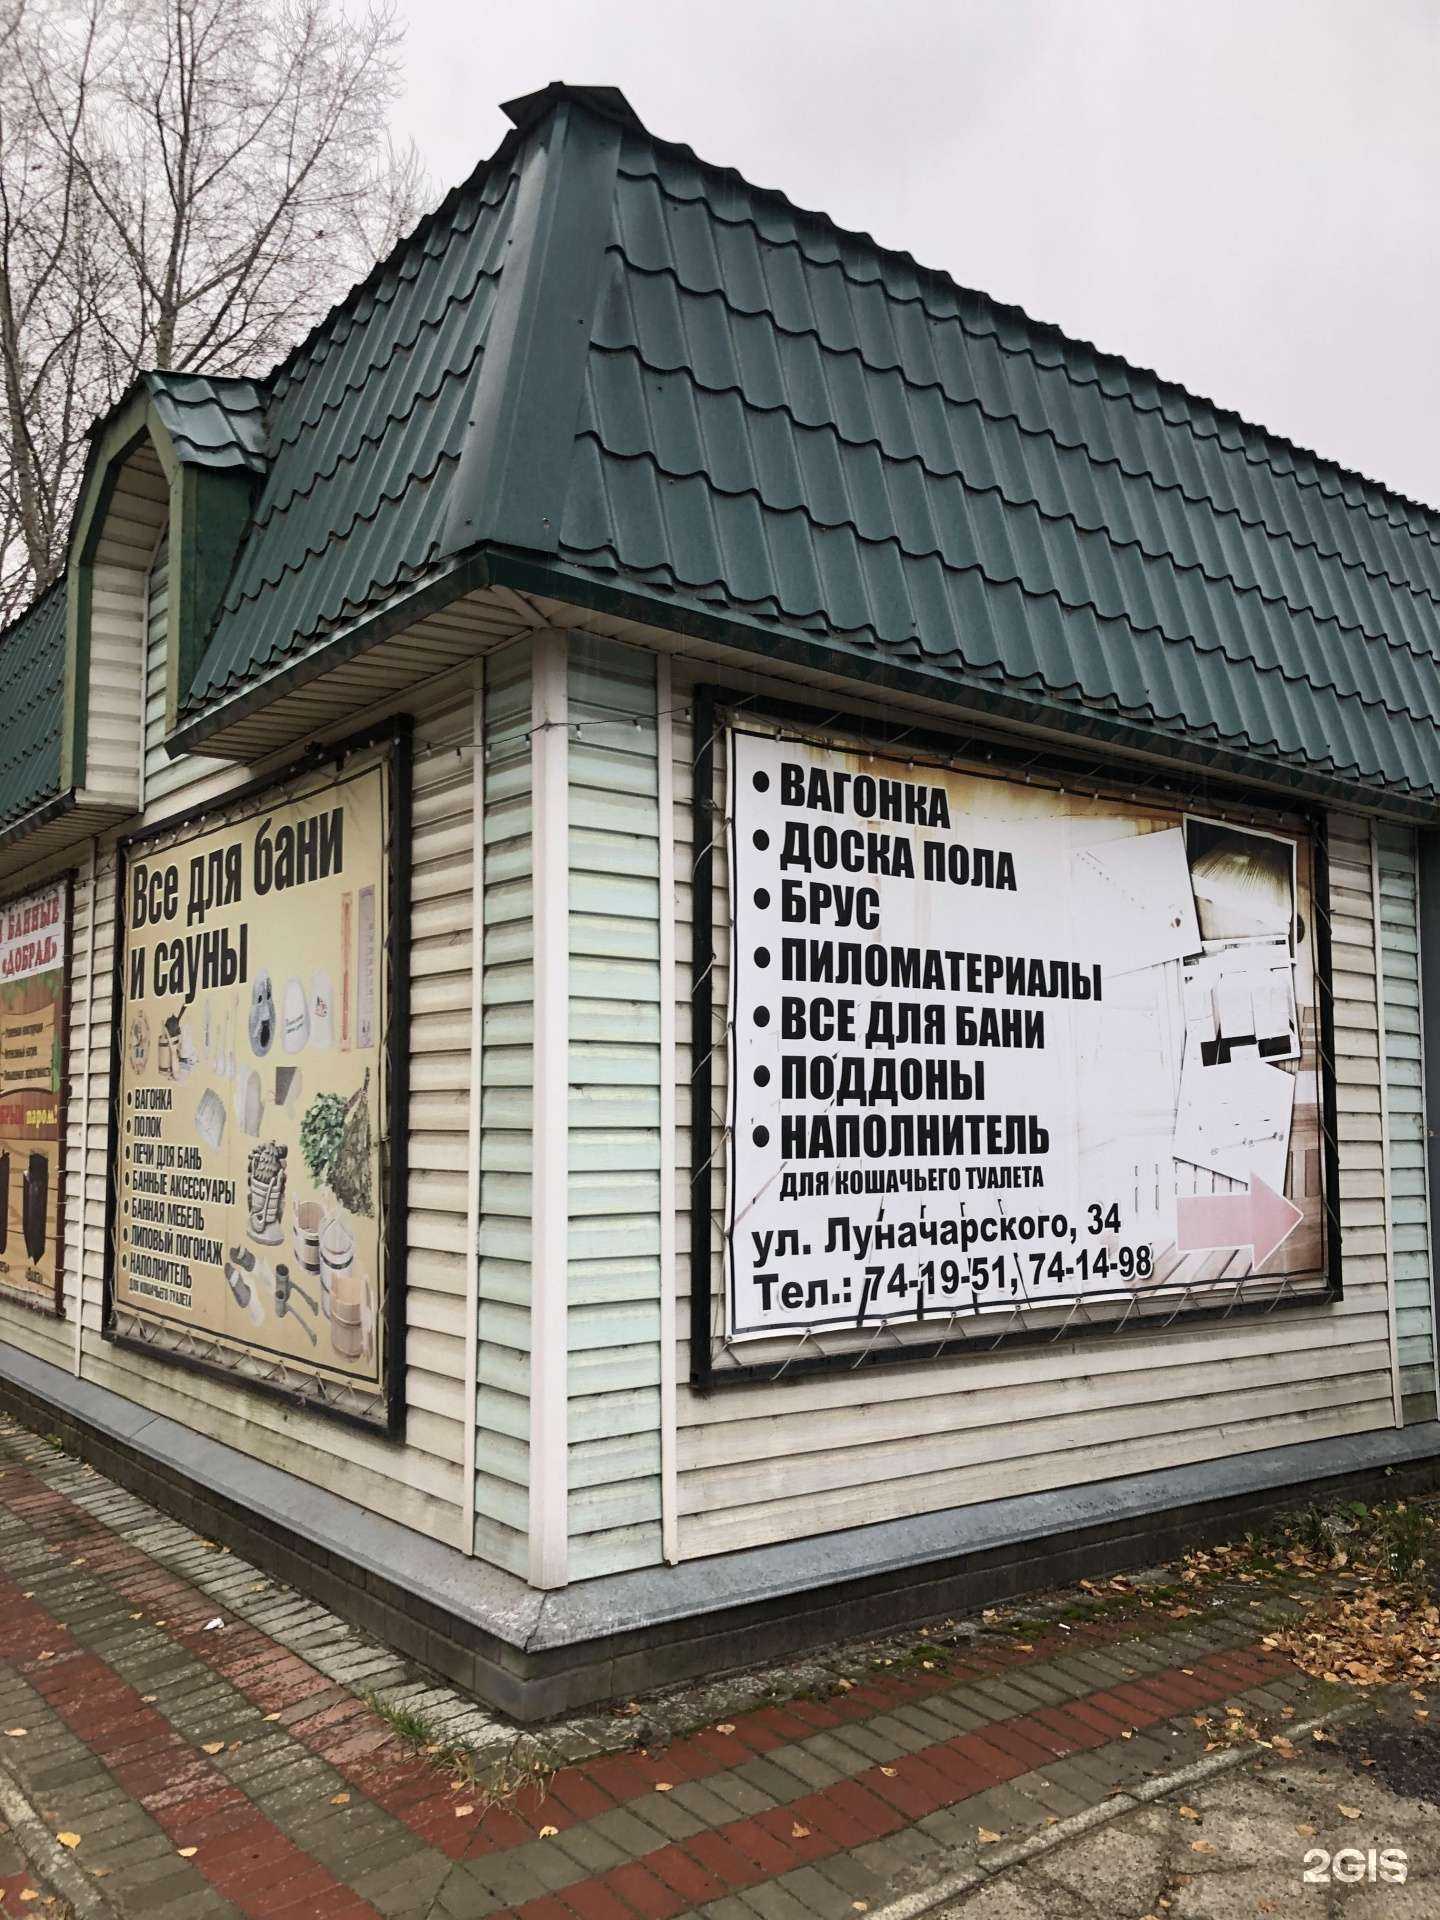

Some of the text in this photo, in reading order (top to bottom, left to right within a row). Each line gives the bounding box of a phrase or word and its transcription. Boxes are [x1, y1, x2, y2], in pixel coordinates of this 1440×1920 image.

[780, 763, 951, 829] ВАГОНКА
[132, 807, 343, 929] Все для бани
[780, 821, 1017, 892] ДОСКА ПОЛА
[781, 880, 880, 930] БРУС
[130, 923, 248, 1004] и сауны
[782, 938, 1102, 1001] ПИЛОМАТЕРИАЛЫ
[782, 997, 1045, 1050] ВСЕ ДЛЯ БАНИ
[135, 1089, 172, 1110] ВАГОНКА
[782, 1056, 985, 1106] ПОДДОНЫ
[134, 1116, 161, 1137] ПОЛОК
[782, 1115, 1050, 1160] НАПОЛНИТЕЛЬ
[134, 1143, 202, 1170] ПЕЧИ ДЛЯ БАНЬ
[132, 1170, 236, 1205] БАННЫЕ АКСЕССУАРЫ
[779, 1165, 1045, 1201] ДЛЯ КОШАЧЬЕГО ТУАЛЕТА
[132, 1197, 204, 1231] БАННАЯ МЕБЕЛЬ
[751, 1203, 1121, 1268] ул. Луначарского, 34
[130, 1252, 192, 1289] НАПОЛНИТЕЛЬ
[131, 1225, 223, 1266] ЛИПОВЫЙ ПОГОНАЖ
[753, 1244, 1152, 1311] Тел.: 74-19-51, 74-14-98
